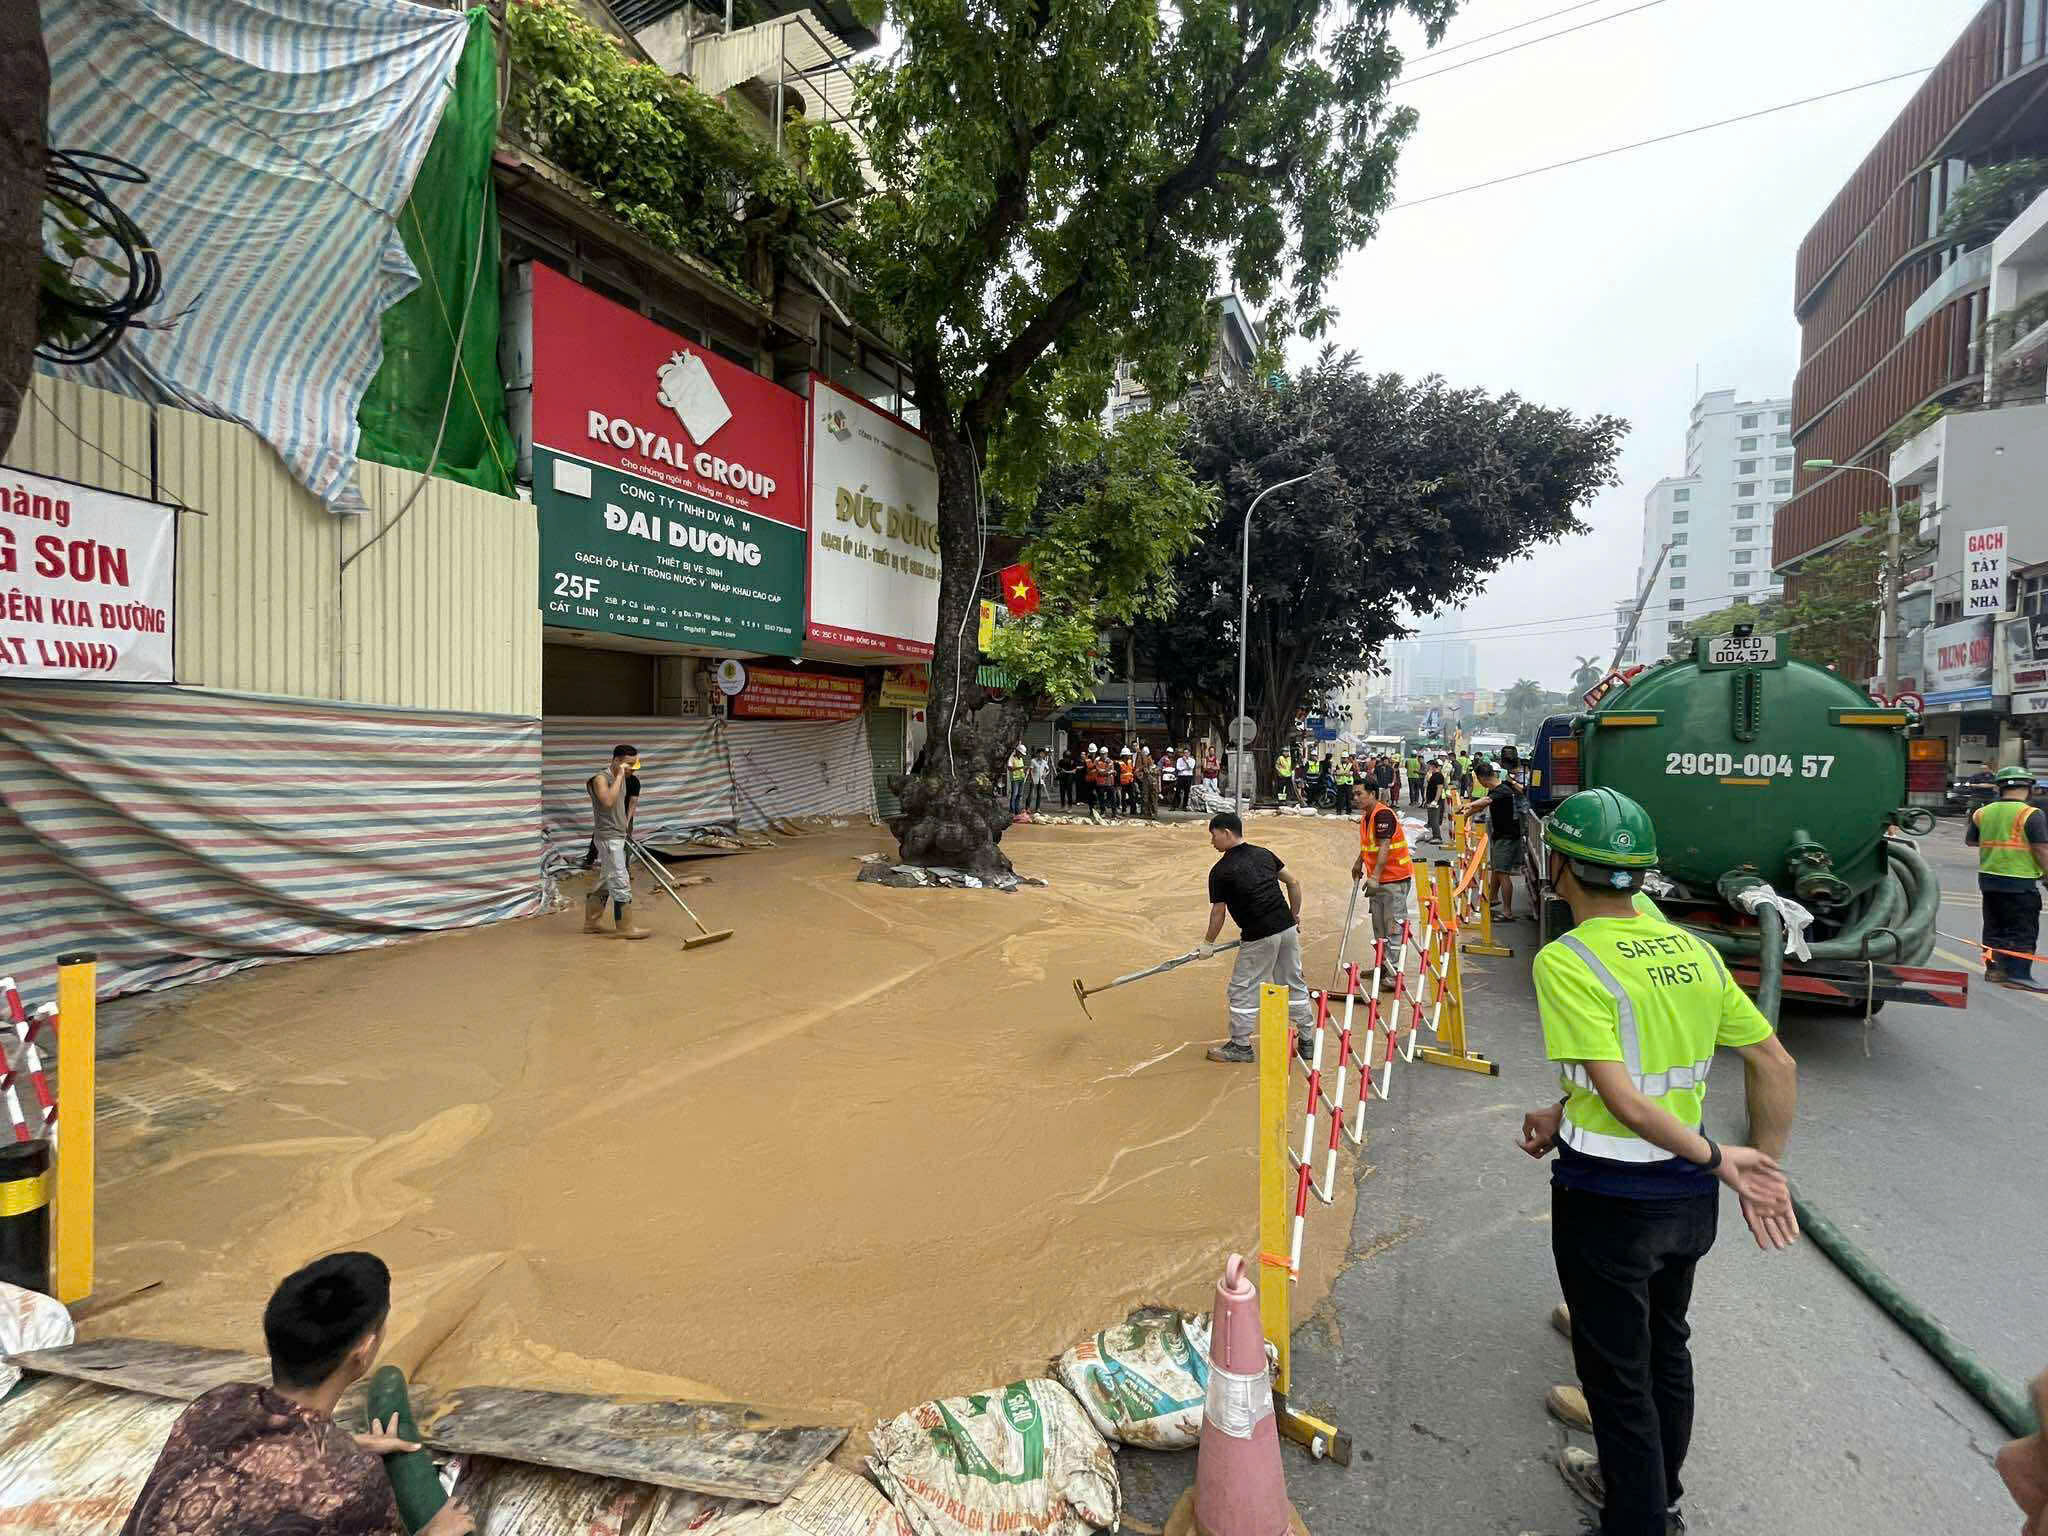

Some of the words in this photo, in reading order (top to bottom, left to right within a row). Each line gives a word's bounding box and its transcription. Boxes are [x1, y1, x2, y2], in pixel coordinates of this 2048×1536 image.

[588, 410, 689, 470] ROYAL
[693, 453, 777, 500] GROUP
[621, 457, 638, 470] Cho
[659, 494, 674, 509] TY
[677, 500, 705, 518] TNHH
[706, 510, 720, 523] DV
[723, 514, 735, 528] VÀ
[669, 521, 762, 566] DƯƠNG
[1968, 532, 2003, 555] GẠCH
[35, 535, 130, 588] SƠN
[705, 567, 723, 578] SINH
[1971, 557, 1999, 573] TÂY
[553, 572, 600, 600] 25F
[574, 551, 603, 566] GẠCH
[641, 566, 671, 581] TRONG
[752, 590, 766, 600] CAO
[1971, 577, 1999, 590] BAN
[549, 600, 570, 613] CÁT
[576, 605, 599, 617] LINH
[1970, 595, 1999, 608] NHA
[51, 598, 94, 628] KIA
[100, 600, 166, 634] ĐƯỜNG
[36, 639, 118, 672] LINH)
[1716, 649, 1769, 662] 004.57
[1722, 637, 1762, 650] 29CD
[1616, 934, 1694, 959] SAFETY
[1646, 962, 1703, 988] FIRST
